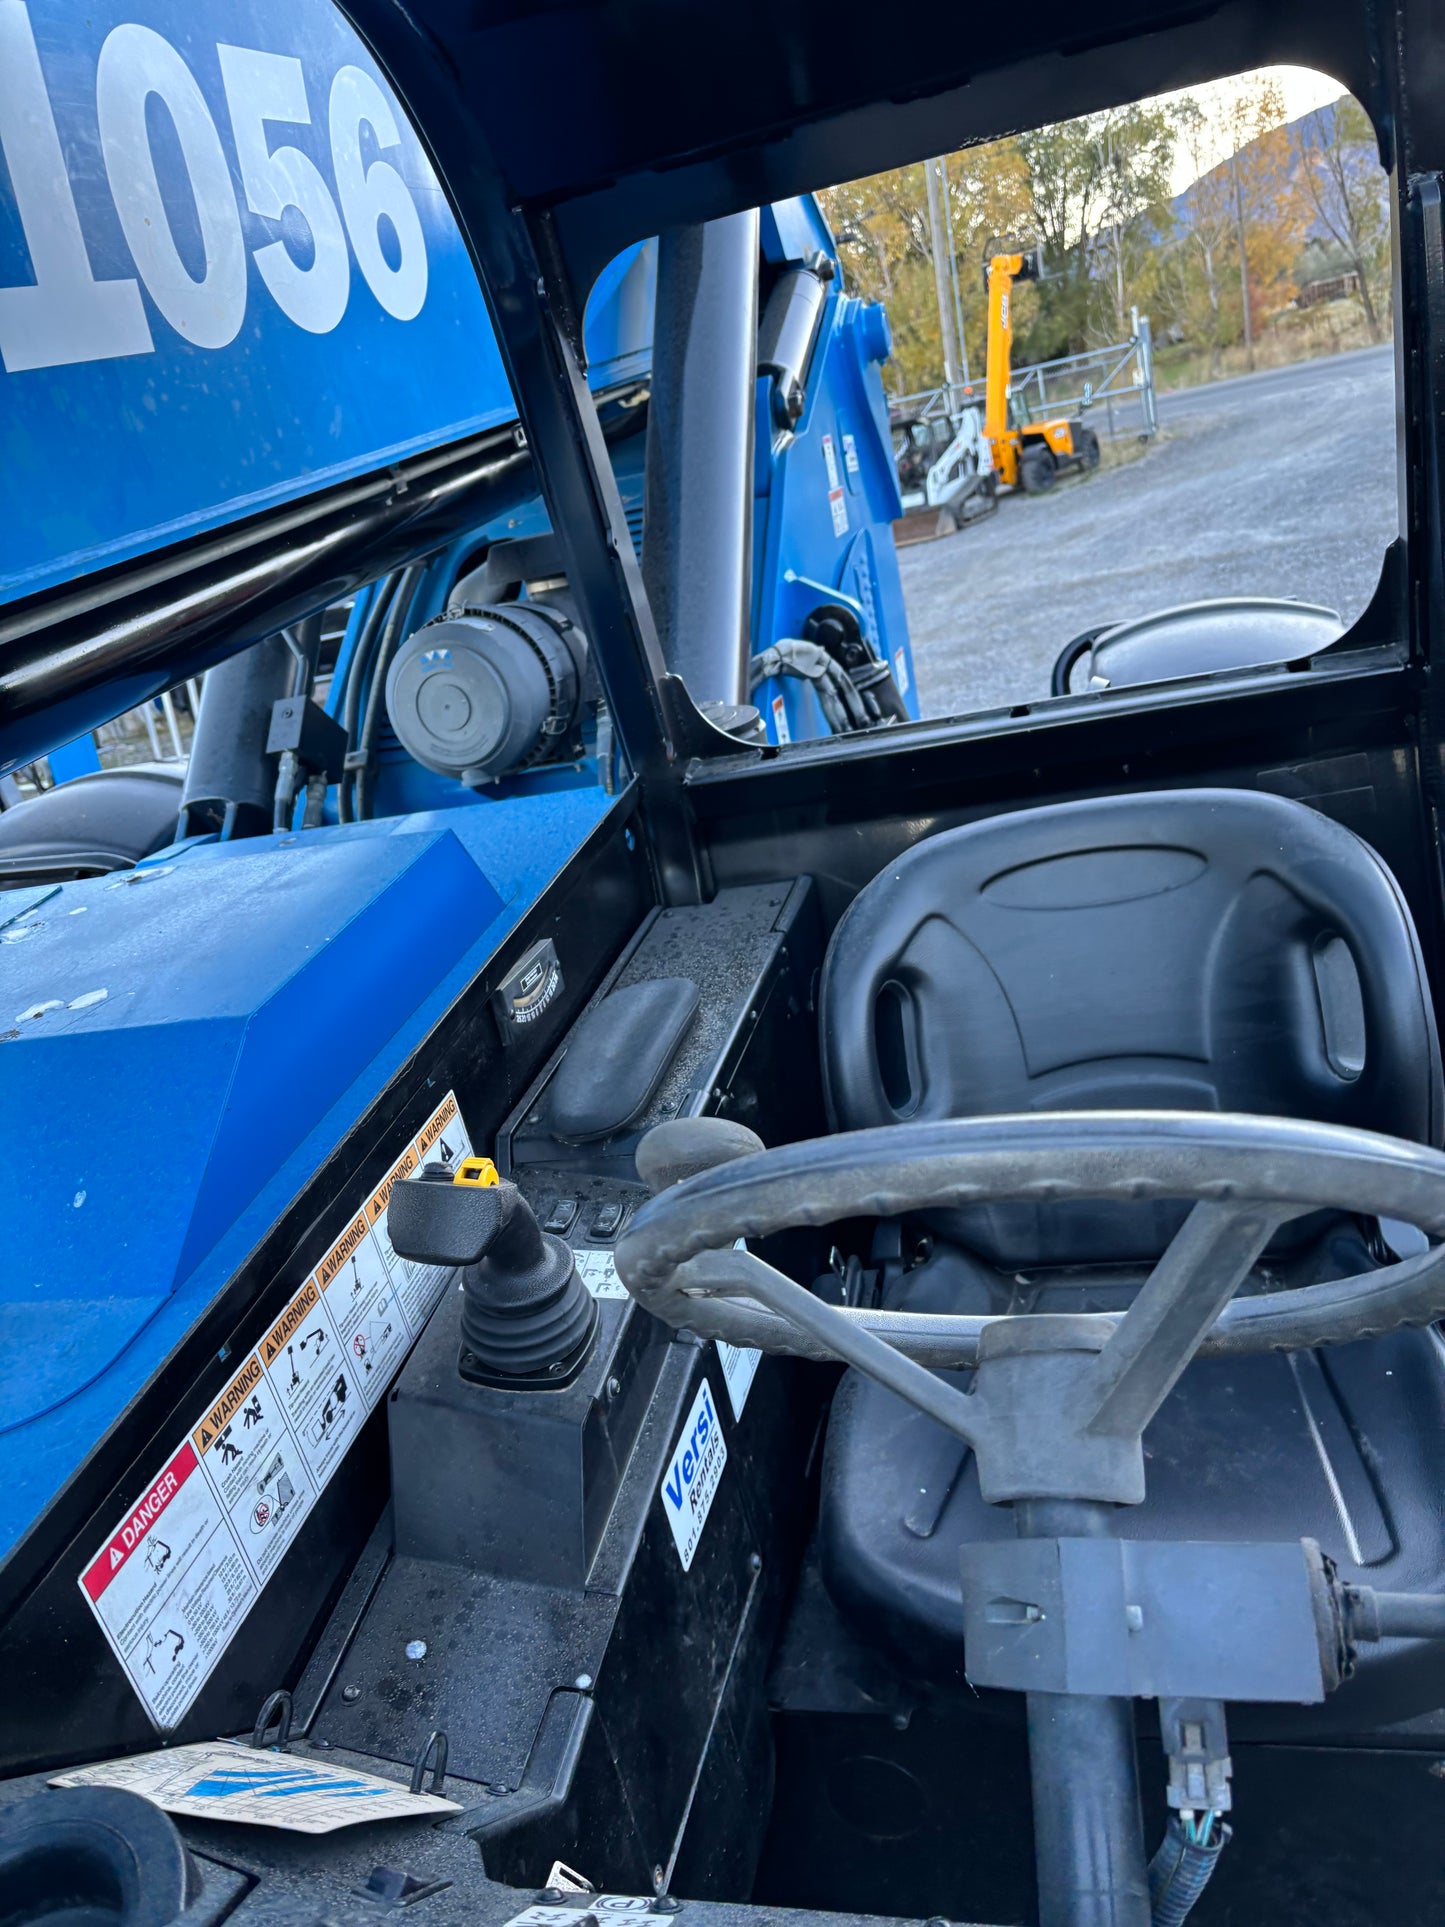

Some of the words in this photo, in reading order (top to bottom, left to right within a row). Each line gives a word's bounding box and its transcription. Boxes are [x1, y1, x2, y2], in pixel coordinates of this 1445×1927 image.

[0, 0, 428, 373] 1056
[425, 1099, 456, 1143] WARNING
[326, 1218, 365, 1274] WARNING
[272, 1284, 315, 1347] WARNING
[209, 1358, 260, 1431] WARNING
[665, 1388, 714, 1511] Versi
[689, 1431, 720, 1516] Rentals
[120, 1470, 178, 1548] DANGER
[683, 1448, 726, 1564] 801.875.2903
